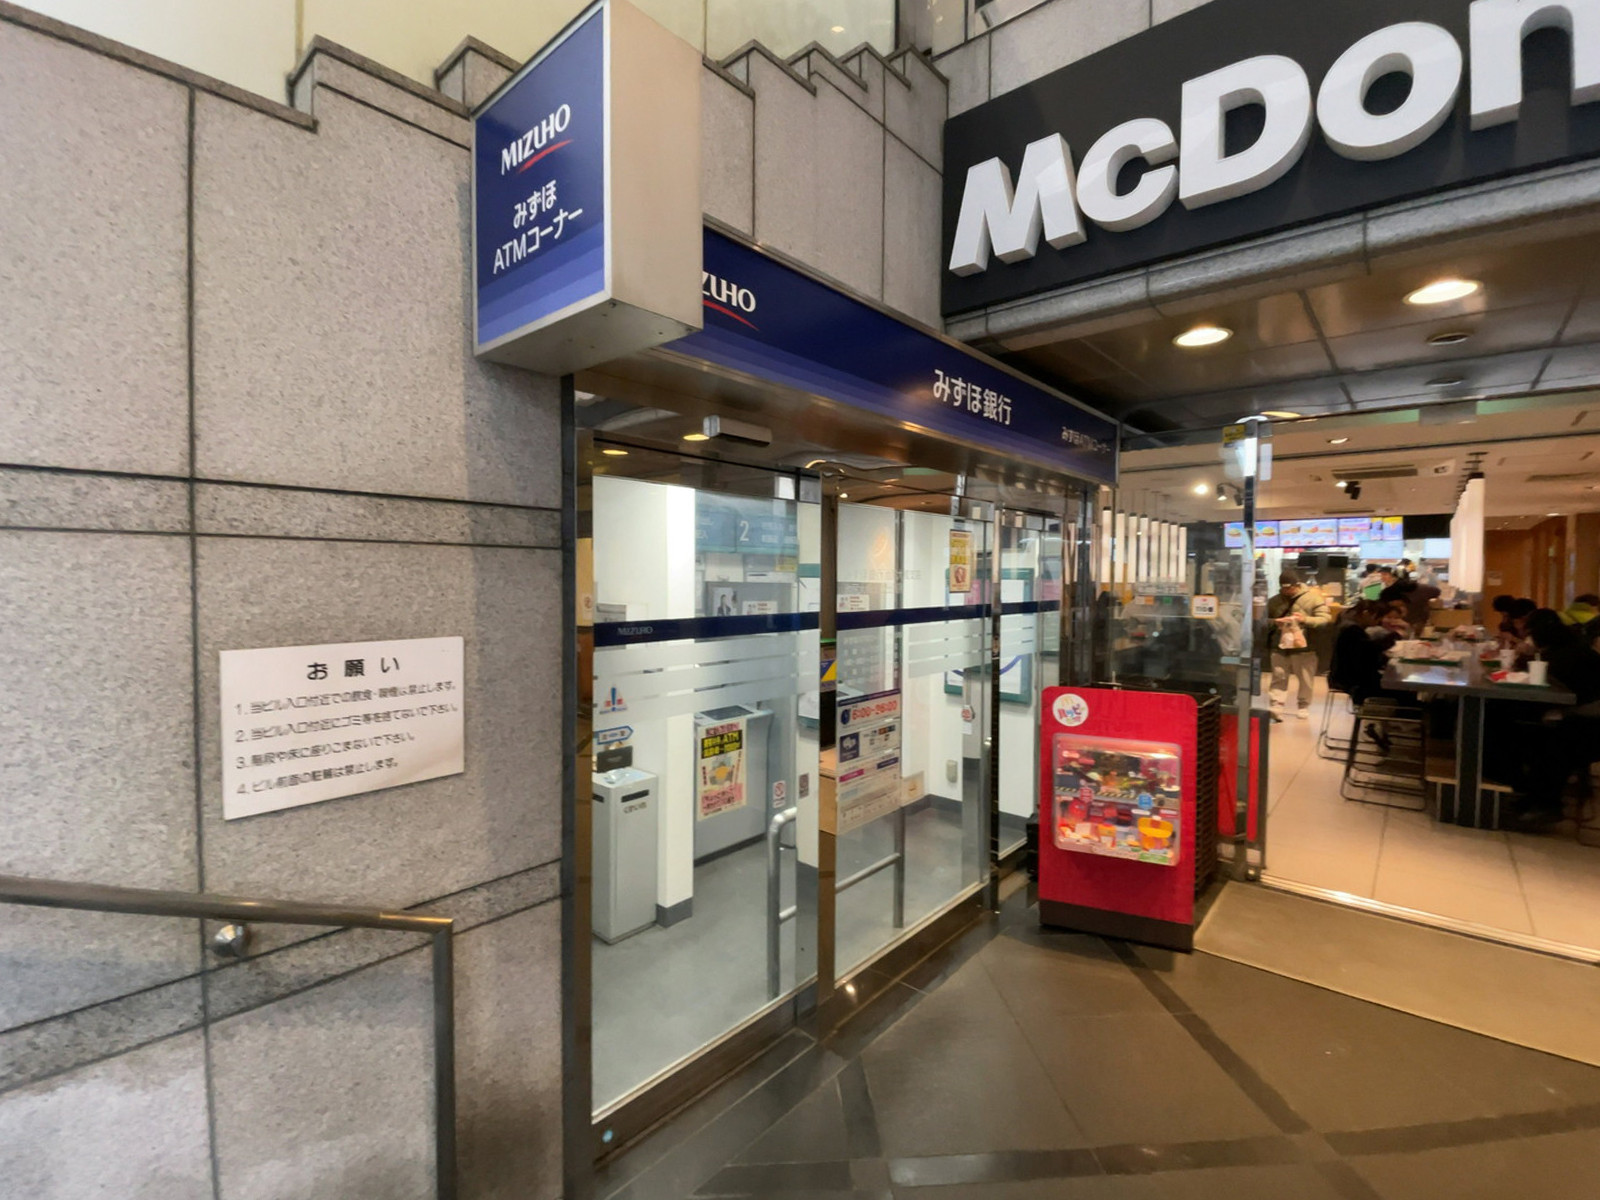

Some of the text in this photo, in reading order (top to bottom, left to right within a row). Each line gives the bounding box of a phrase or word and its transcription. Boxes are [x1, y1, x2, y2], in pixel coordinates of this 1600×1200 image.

[501, 103, 571, 176] MIZUHO
[513, 179, 557, 229] みずほ
[493, 208, 583, 275] ATMコーナー
[702, 270, 757, 313] ZUHO
[932, 369, 1012, 426] みずほ銀行
[739, 520, 750, 542] 2
[306, 656, 401, 681] お願い
